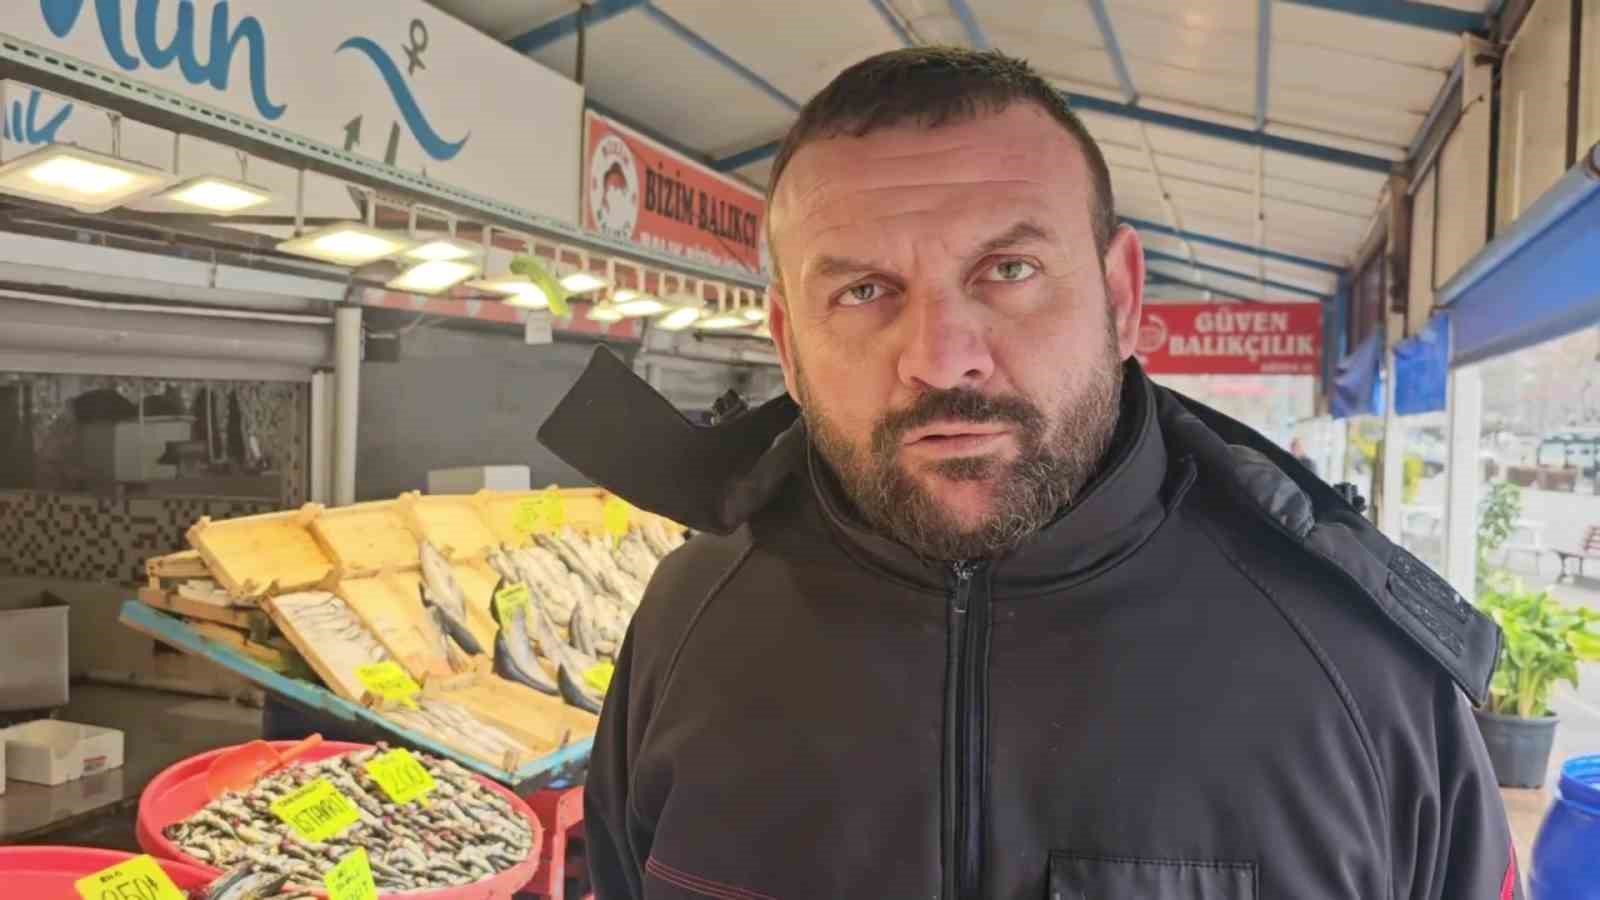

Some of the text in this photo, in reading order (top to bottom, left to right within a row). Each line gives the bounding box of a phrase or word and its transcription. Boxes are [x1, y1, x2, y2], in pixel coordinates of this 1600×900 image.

[645, 161, 758, 250] BİZİM BALIKÇI
[1194, 306, 1289, 333] GÜVEN
[1168, 334, 1313, 362] BALIKÇILIK
